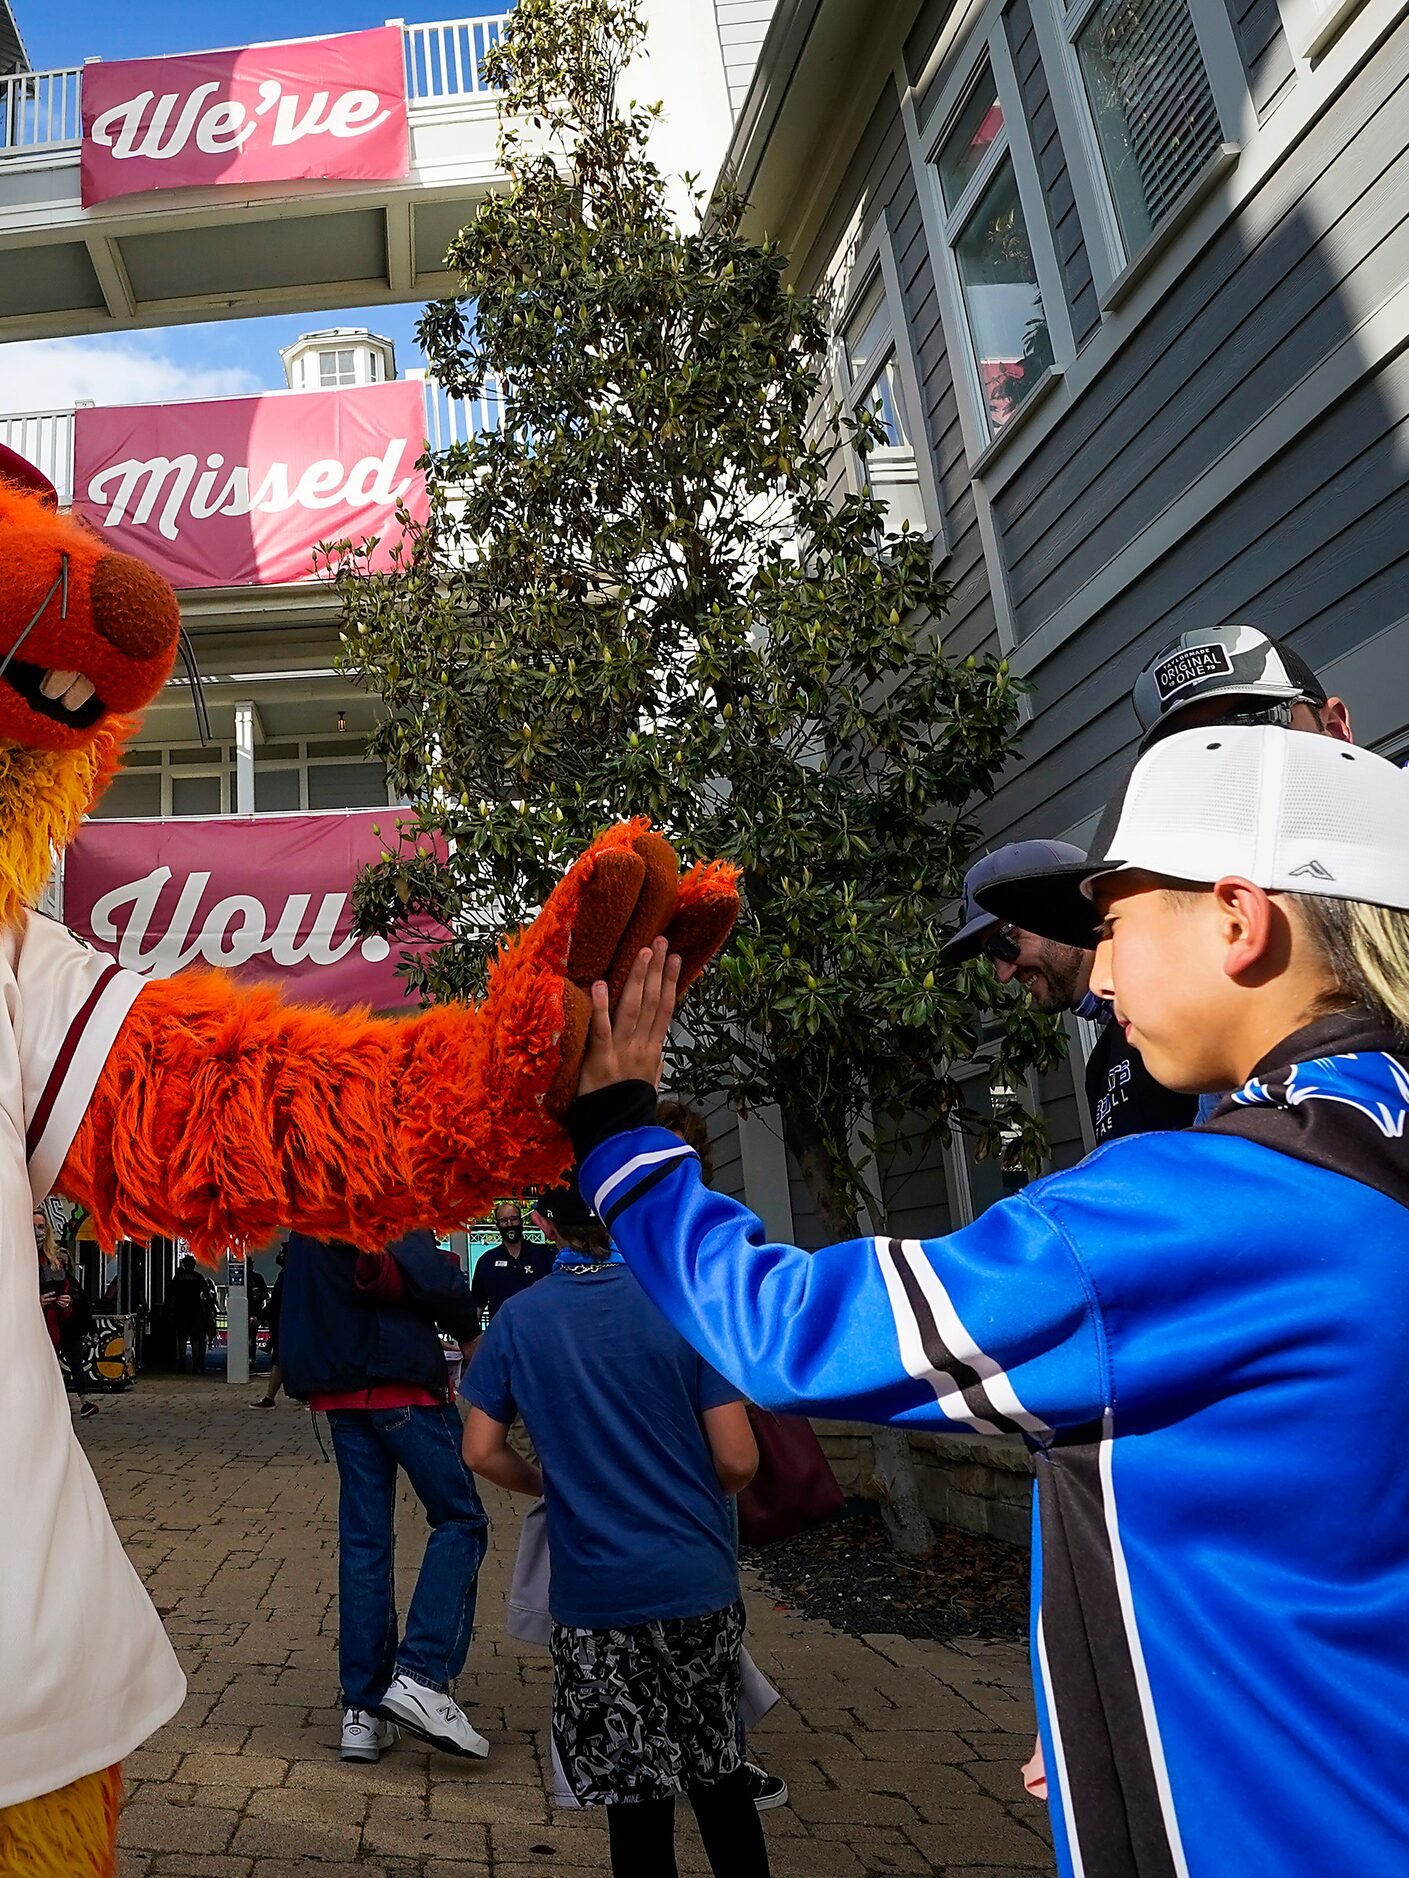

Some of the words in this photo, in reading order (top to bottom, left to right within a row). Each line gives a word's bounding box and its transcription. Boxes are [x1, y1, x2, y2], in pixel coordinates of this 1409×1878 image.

[91, 79, 392, 160] We've
[87, 438, 413, 541] Missed
[1160, 652, 1222, 686] ORIGINAL
[1162, 648, 1211, 671] TAYLORMADE
[1176, 664, 1206, 684] ONE
[91, 865, 391, 980] You.
[623, 1793, 641, 1804] NIKE
